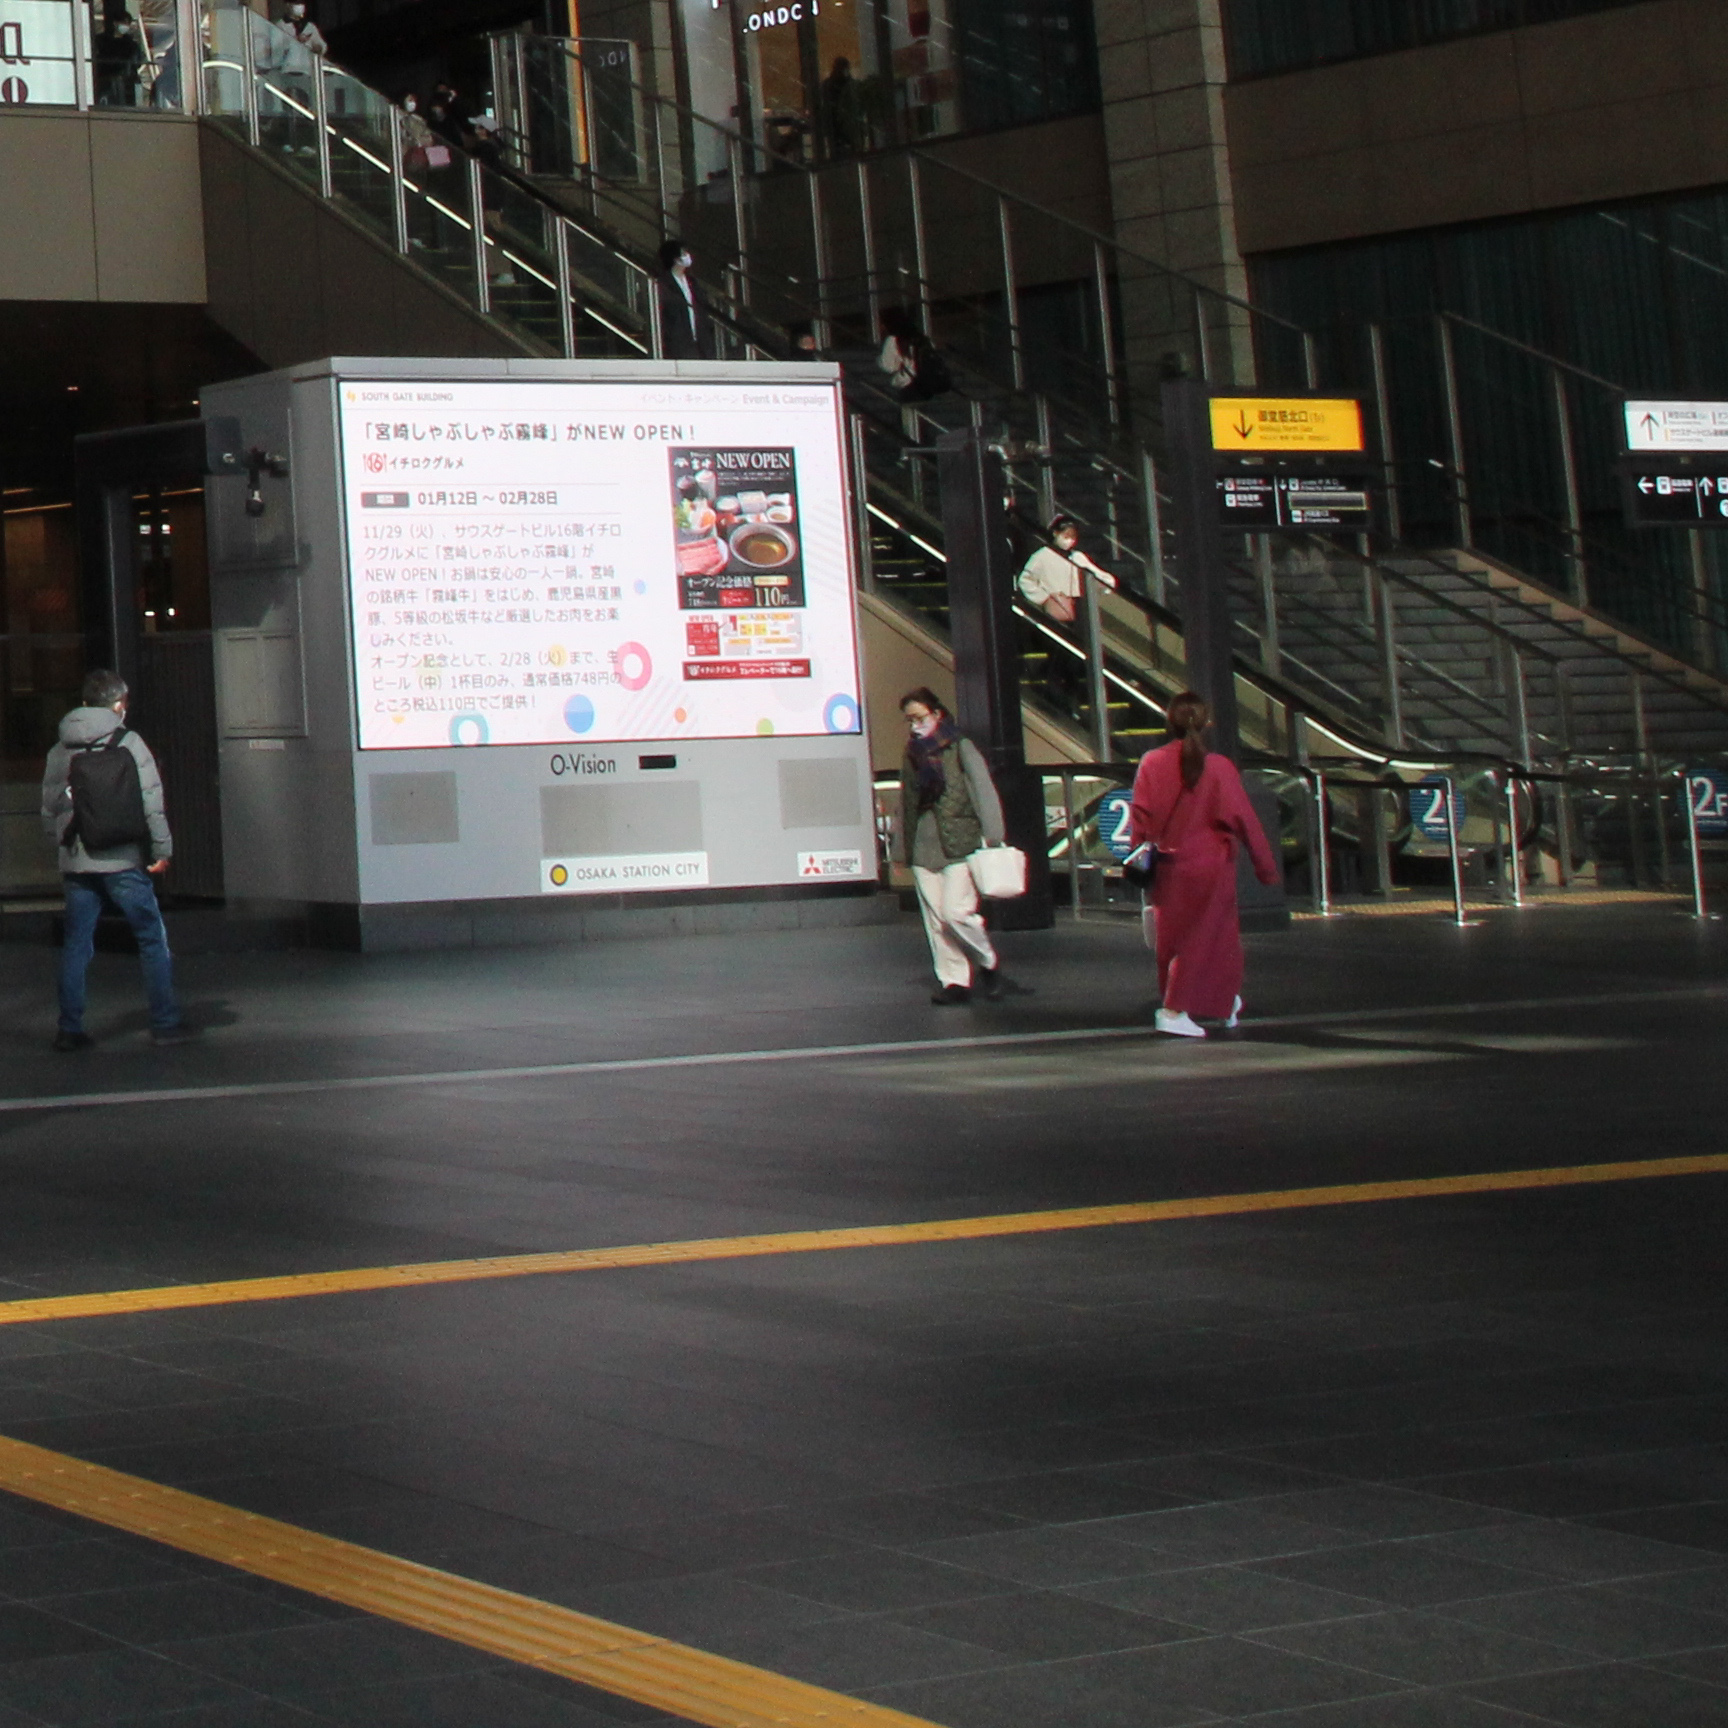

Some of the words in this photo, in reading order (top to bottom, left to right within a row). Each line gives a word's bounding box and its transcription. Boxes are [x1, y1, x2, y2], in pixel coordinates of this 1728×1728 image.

[361, 392, 389, 401] SOUTH
[393, 392, 413, 401] GATE
[416, 392, 453, 401] BUILDING
[743, 394, 769, 405] Event
[772, 394, 780, 404] &
[782, 394, 829, 406] Campaign
[389, 456, 464, 469] イチロクグルメ
[716, 452, 750, 469] NEW
[750, 452, 791, 469] OPEN
[418, 491, 477, 506] 01月12日
[499, 490, 558, 506] 02月28日
[365, 568, 395, 582] NEW
[370, 633, 454, 647] しみください。
[550, 753, 616, 776] O-Vision
[576, 867, 617, 880] OSAKA
[622, 864, 671, 878] STATION
[675, 863, 700, 876] CITY
